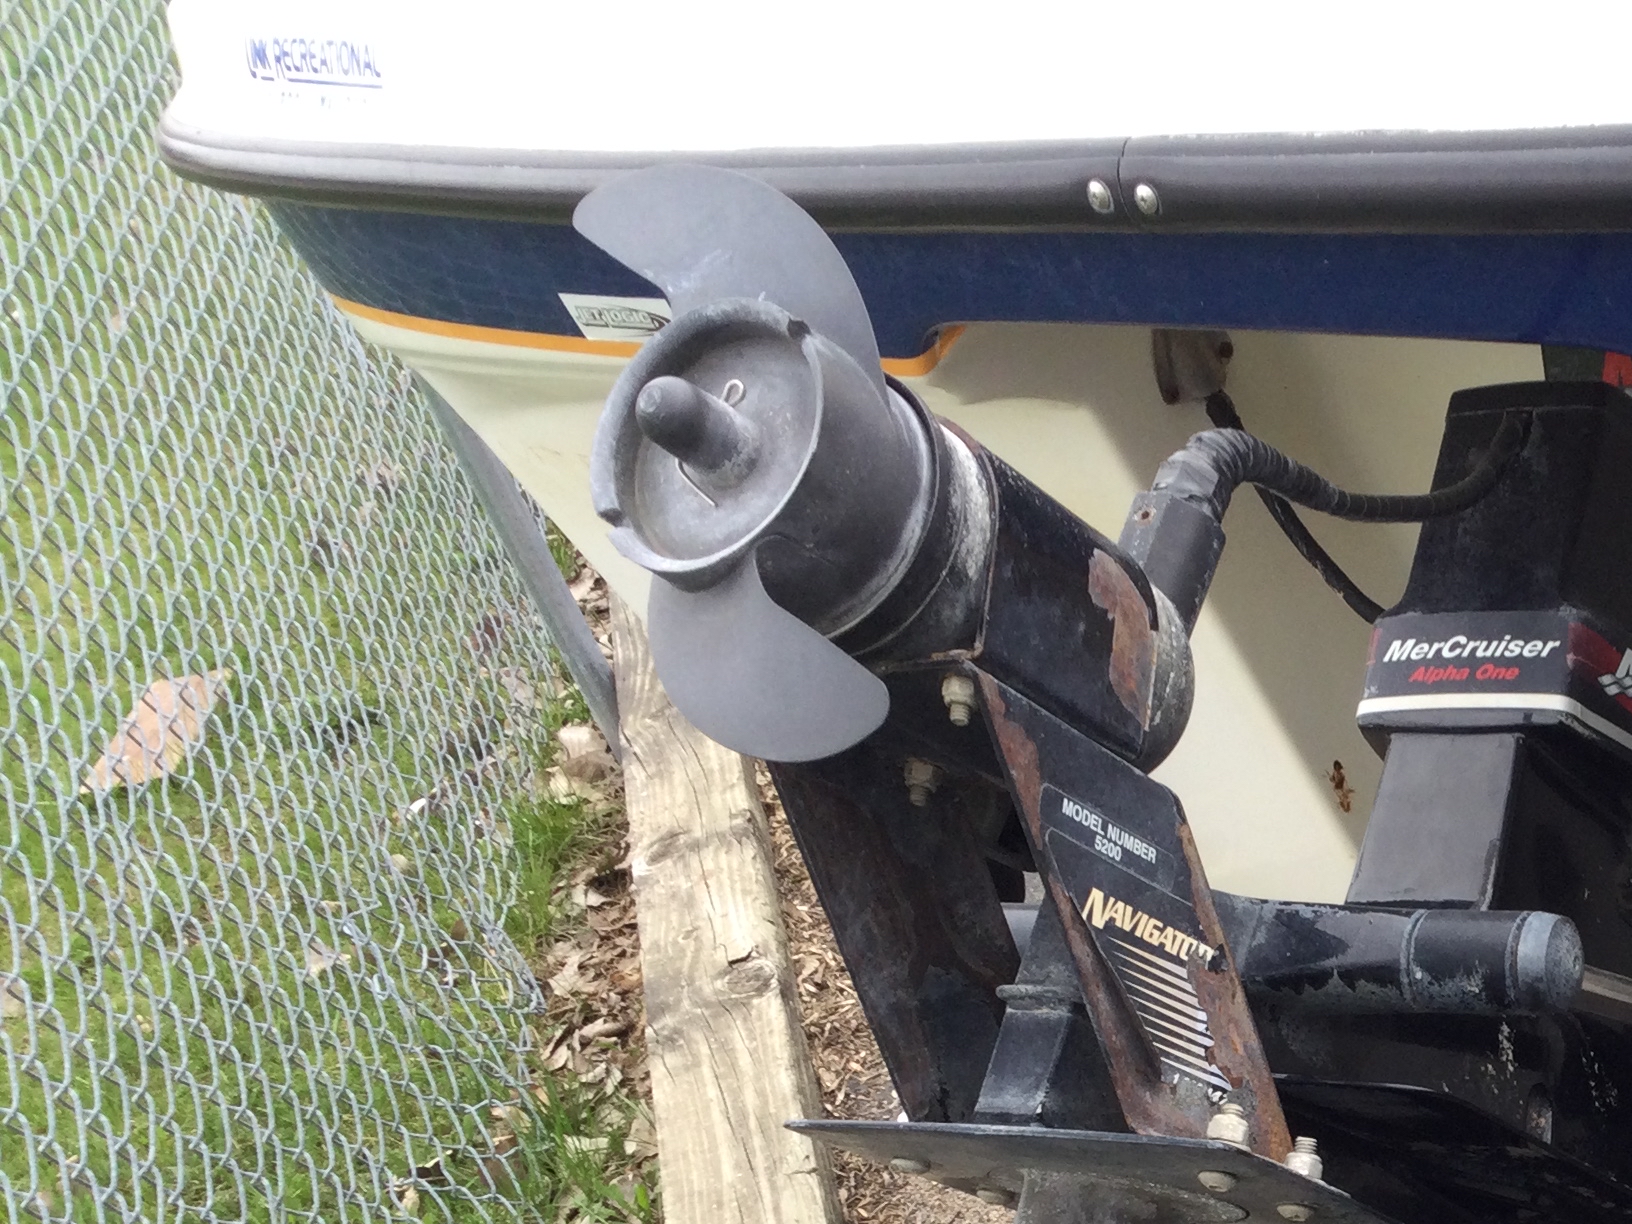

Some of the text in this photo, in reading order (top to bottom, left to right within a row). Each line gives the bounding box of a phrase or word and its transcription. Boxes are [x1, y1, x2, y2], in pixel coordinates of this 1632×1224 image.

[272, 36, 382, 79] RECREATIONAL
[1383, 634, 1561, 664] MerCruiser
[1408, 662, 1521, 685] Alpha One
[1061, 797, 1158, 865] MODEL NUMBER
[1093, 834, 1123, 862] 5200
